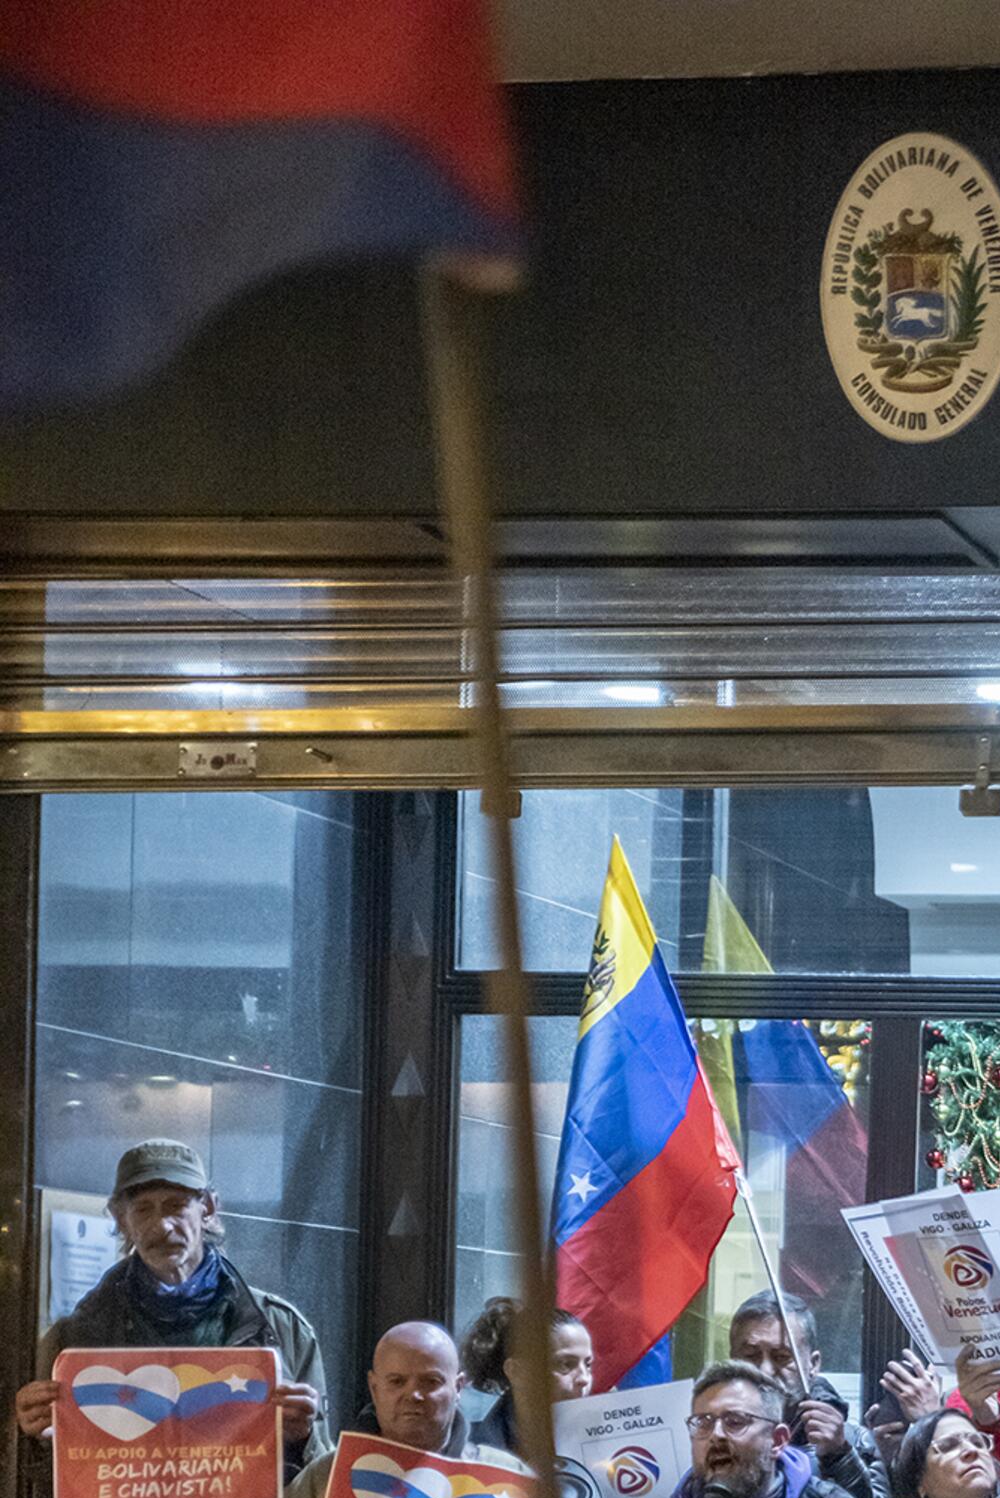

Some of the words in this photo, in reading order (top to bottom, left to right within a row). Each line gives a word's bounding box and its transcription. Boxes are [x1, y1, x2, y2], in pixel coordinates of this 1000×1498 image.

[858, 146, 961, 200] BOLIVARIANA
[960, 176, 985, 201] DE
[850, 371, 928, 431] CONSULADO
[933, 367, 989, 426] GENERAL
[919, 1224, 944, 1235] VIGO
[951, 1218, 992, 1233] GALIZA
[932, 1209, 970, 1222] DENDE
[603, 1405, 642, 1421] DENDE
[586, 1424, 613, 1437] VIGO
[623, 1415, 664, 1432] GALIZA
[68, 1447, 91, 1460] EU
[95, 1447, 145, 1459] APOIO
[150, 1446, 162, 1459] A
[165, 1444, 267, 1459] VENEZUELA
[97, 1456, 244, 1480] BOLIVARIANA
[117, 1476, 232, 1498] CHAVISTA!
